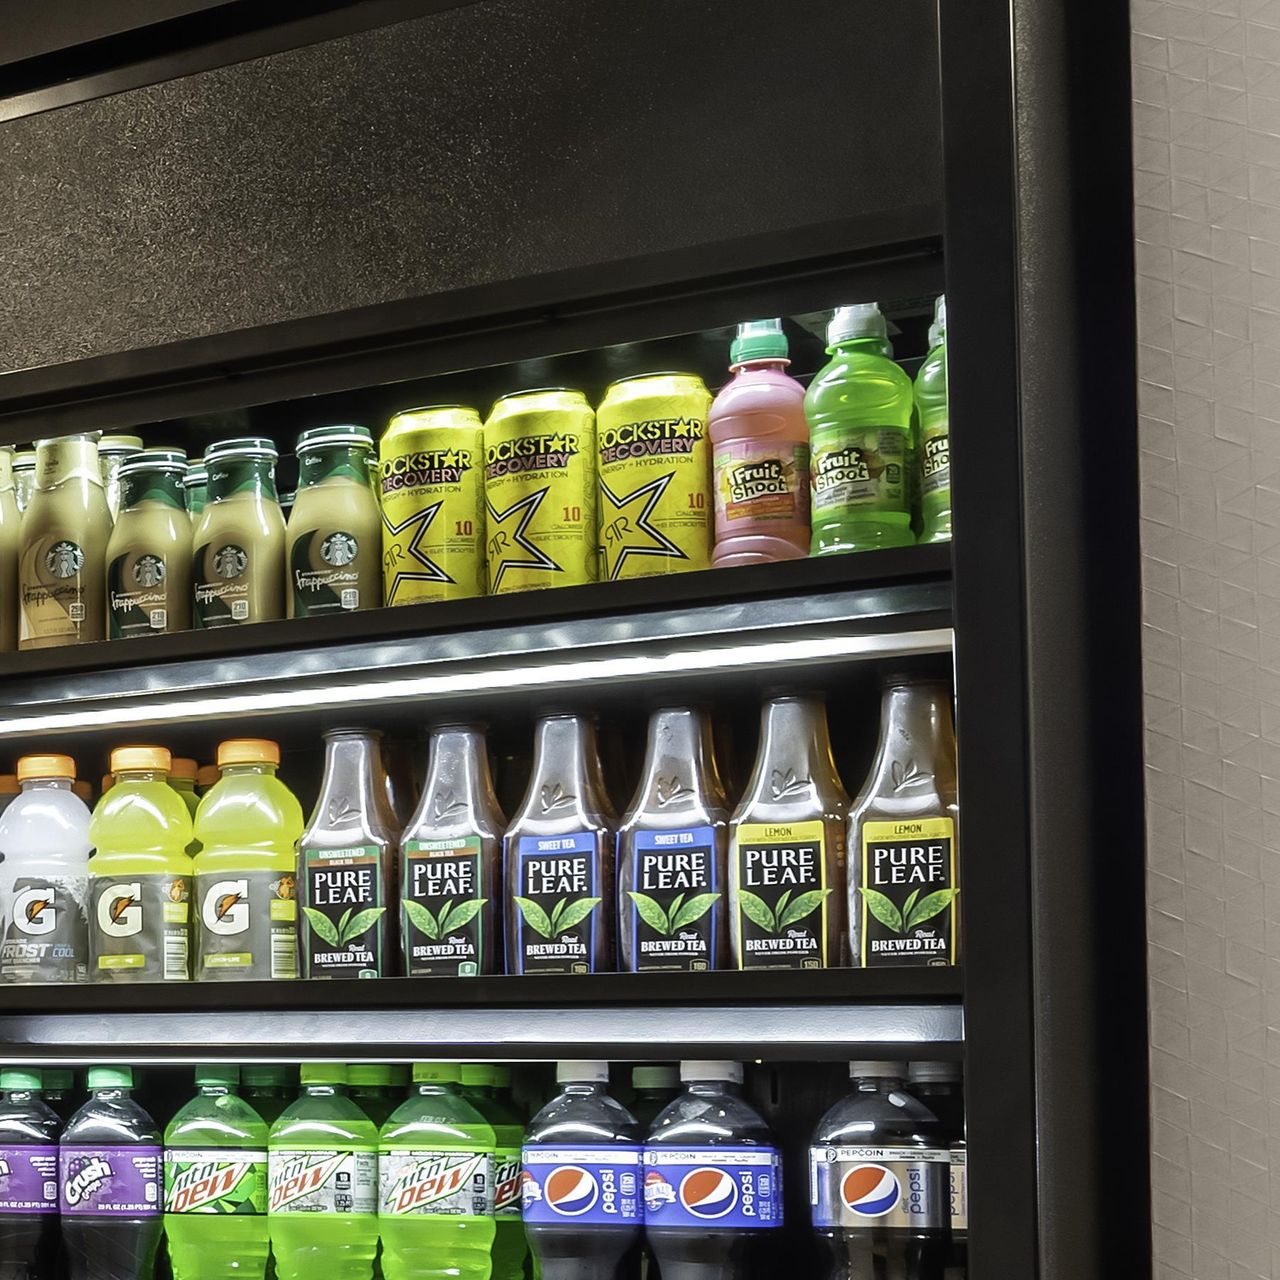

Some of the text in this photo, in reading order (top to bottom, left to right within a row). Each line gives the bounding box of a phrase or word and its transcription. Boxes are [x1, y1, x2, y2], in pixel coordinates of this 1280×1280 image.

[601, 438, 695, 465] RECOVERY
[734, 463, 779, 485] Fruit
[407, 484, 462, 496] HYDRATION
[733, 481, 786, 501] Shoot
[562, 506, 581, 522] 10
[764, 827, 792, 837] LEMON
[894, 824, 922, 834] LEMON
[538, 840, 576, 850] SWEET TEA
[654, 833, 694, 844] SWEET TEA
[315, 870, 371, 888] PURE
[414, 861, 472, 880] PURE
[97, 882, 143, 938] G
[202, 879, 250, 936] G
[413, 944, 475, 957] BREWED TEA
[526, 943, 587, 955] BREWED TEA
[640, 940, 706, 952] BREWED TEA
[314, 952, 374, 964] BREWED TEA
[840, 1149, 884, 1158] PEPCOIN
[65, 1156, 112, 1203] Crush
[740, 1170, 755, 1216] pepsi
[909, 1167, 925, 1215] pepsi
[901, 1196, 910, 1214] diet
